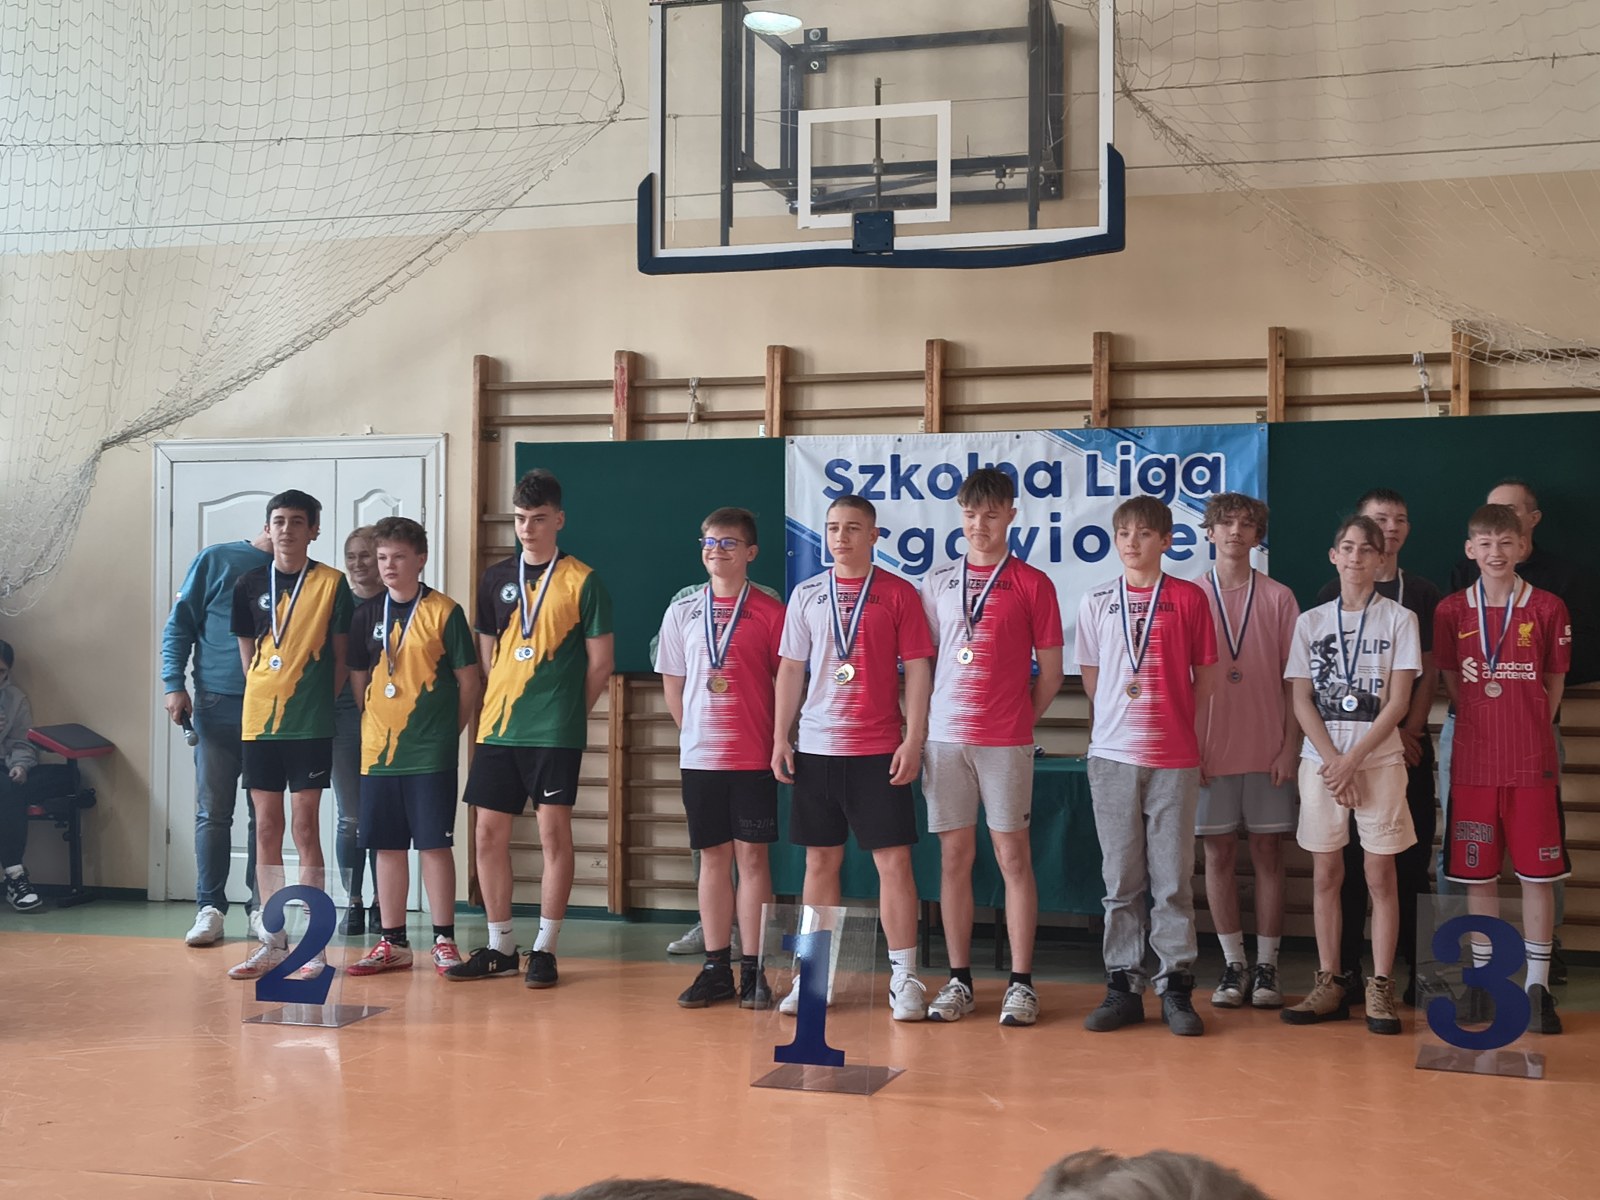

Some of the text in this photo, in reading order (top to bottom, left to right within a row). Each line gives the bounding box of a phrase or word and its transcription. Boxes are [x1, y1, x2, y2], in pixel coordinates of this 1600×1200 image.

[1086, 444, 1222, 506] Liga
[1465, 841, 1479, 868] 8
[255, 884, 337, 1005] 2
[774, 929, 846, 1068] 1
[1426, 914, 1532, 1051] 3
